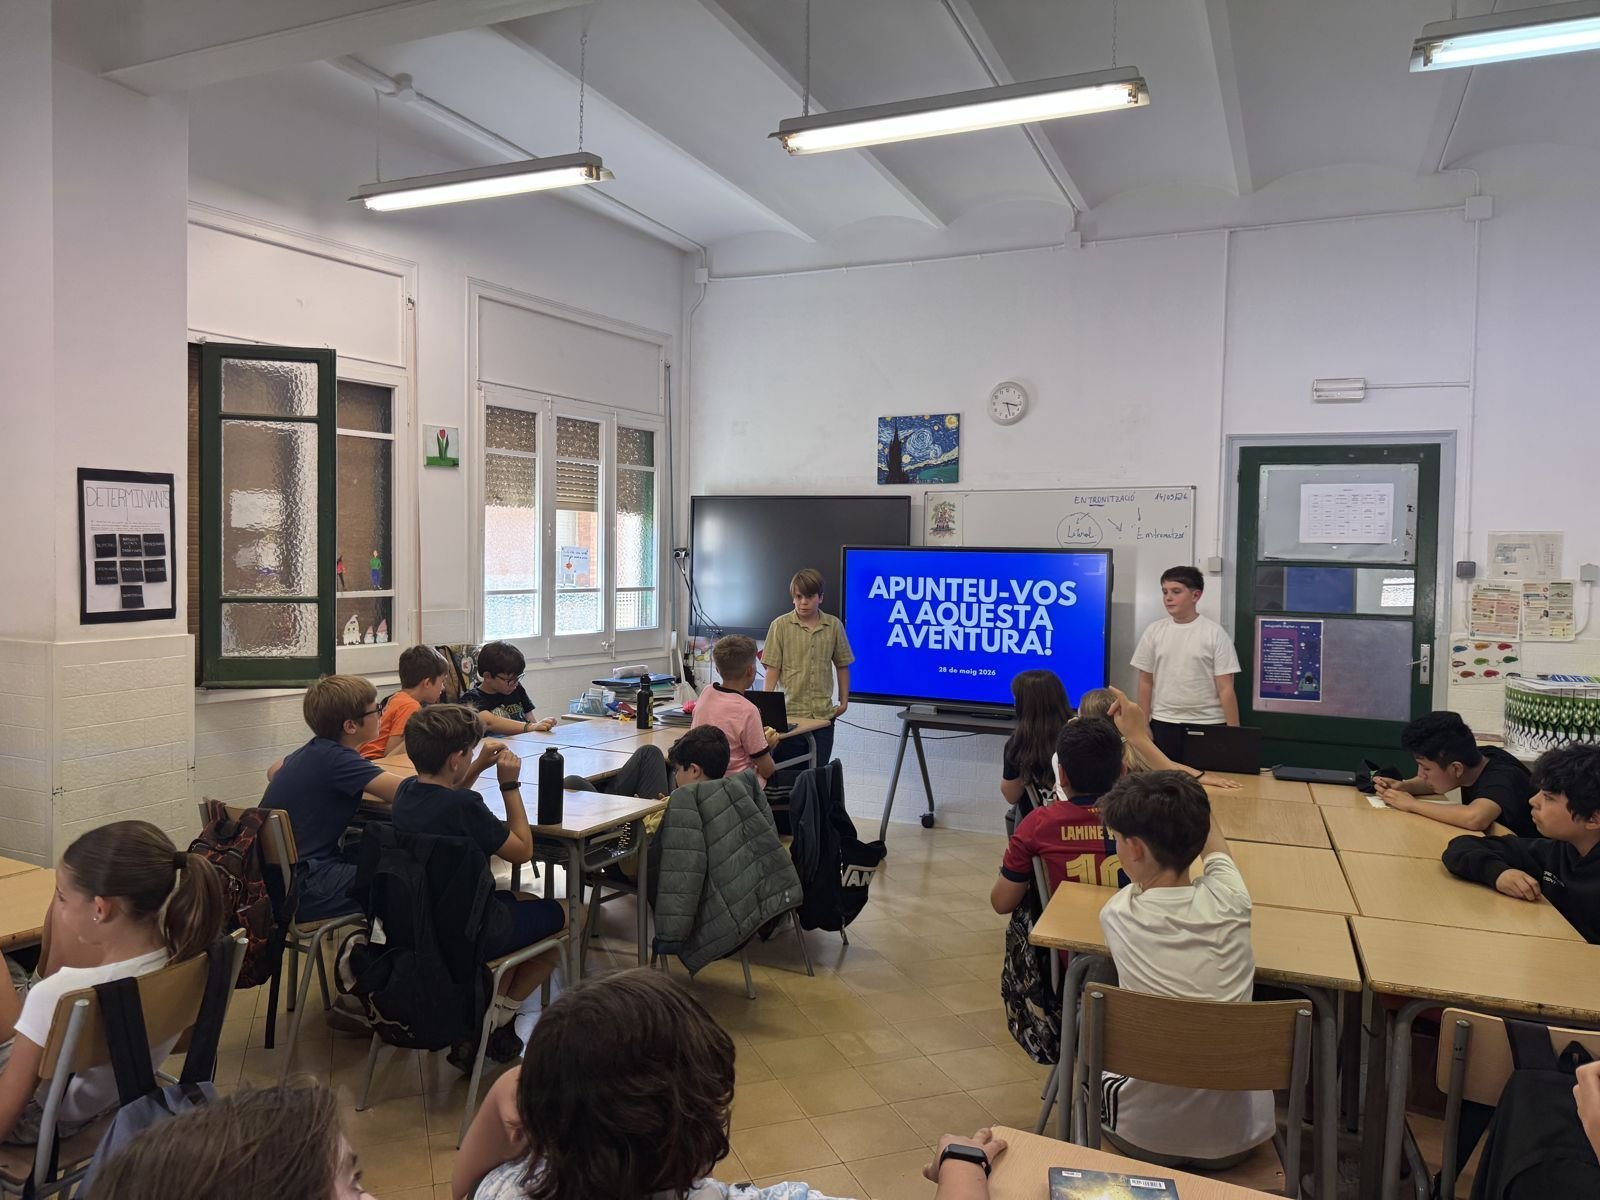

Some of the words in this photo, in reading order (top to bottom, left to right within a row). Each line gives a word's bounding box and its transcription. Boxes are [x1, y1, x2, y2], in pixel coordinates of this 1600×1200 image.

[86, 486, 170, 509] DETERMINANTS
[868, 576, 1078, 606] APUNTEU-VOS
[888, 600, 909, 624] A
[915, 601, 1053, 631] AQUESTA
[887, 624, 1052, 656] AVENTURA!
[948, 666, 958, 674] de
[959, 668, 978, 677] maig
[978, 668, 997, 676] 2026
[1061, 825, 1105, 841] LAMINE
[841, 864, 877, 888] VAN
